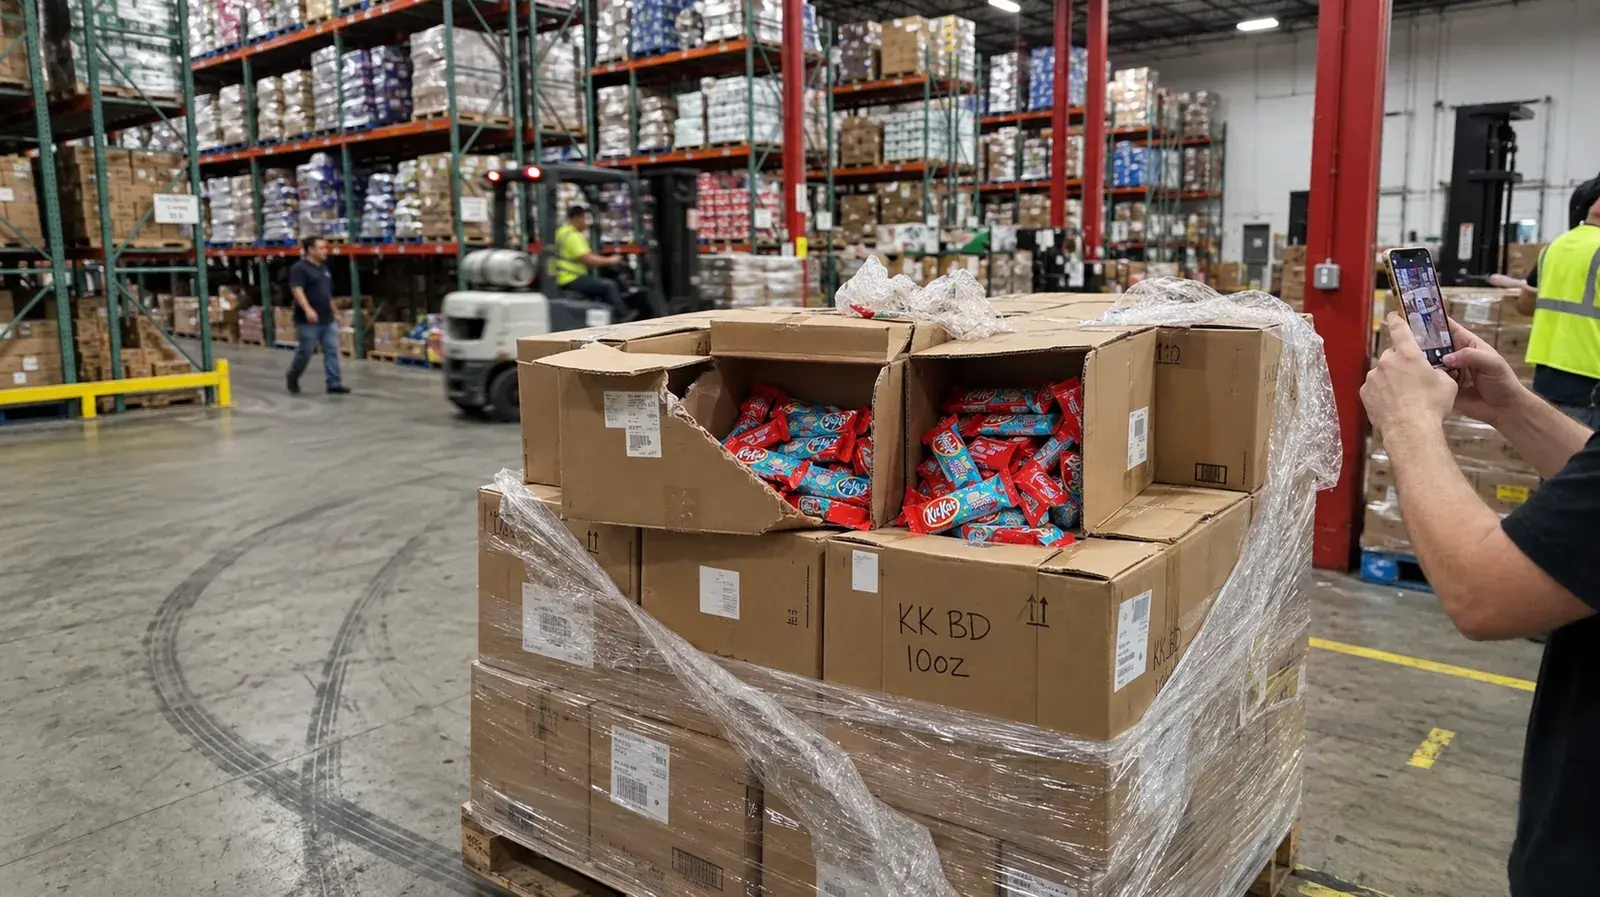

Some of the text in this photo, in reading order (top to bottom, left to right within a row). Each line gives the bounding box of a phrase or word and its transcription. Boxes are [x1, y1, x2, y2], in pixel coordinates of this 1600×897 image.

[899, 602, 991, 641] KK BD
[1153, 637, 1166, 672] KK
